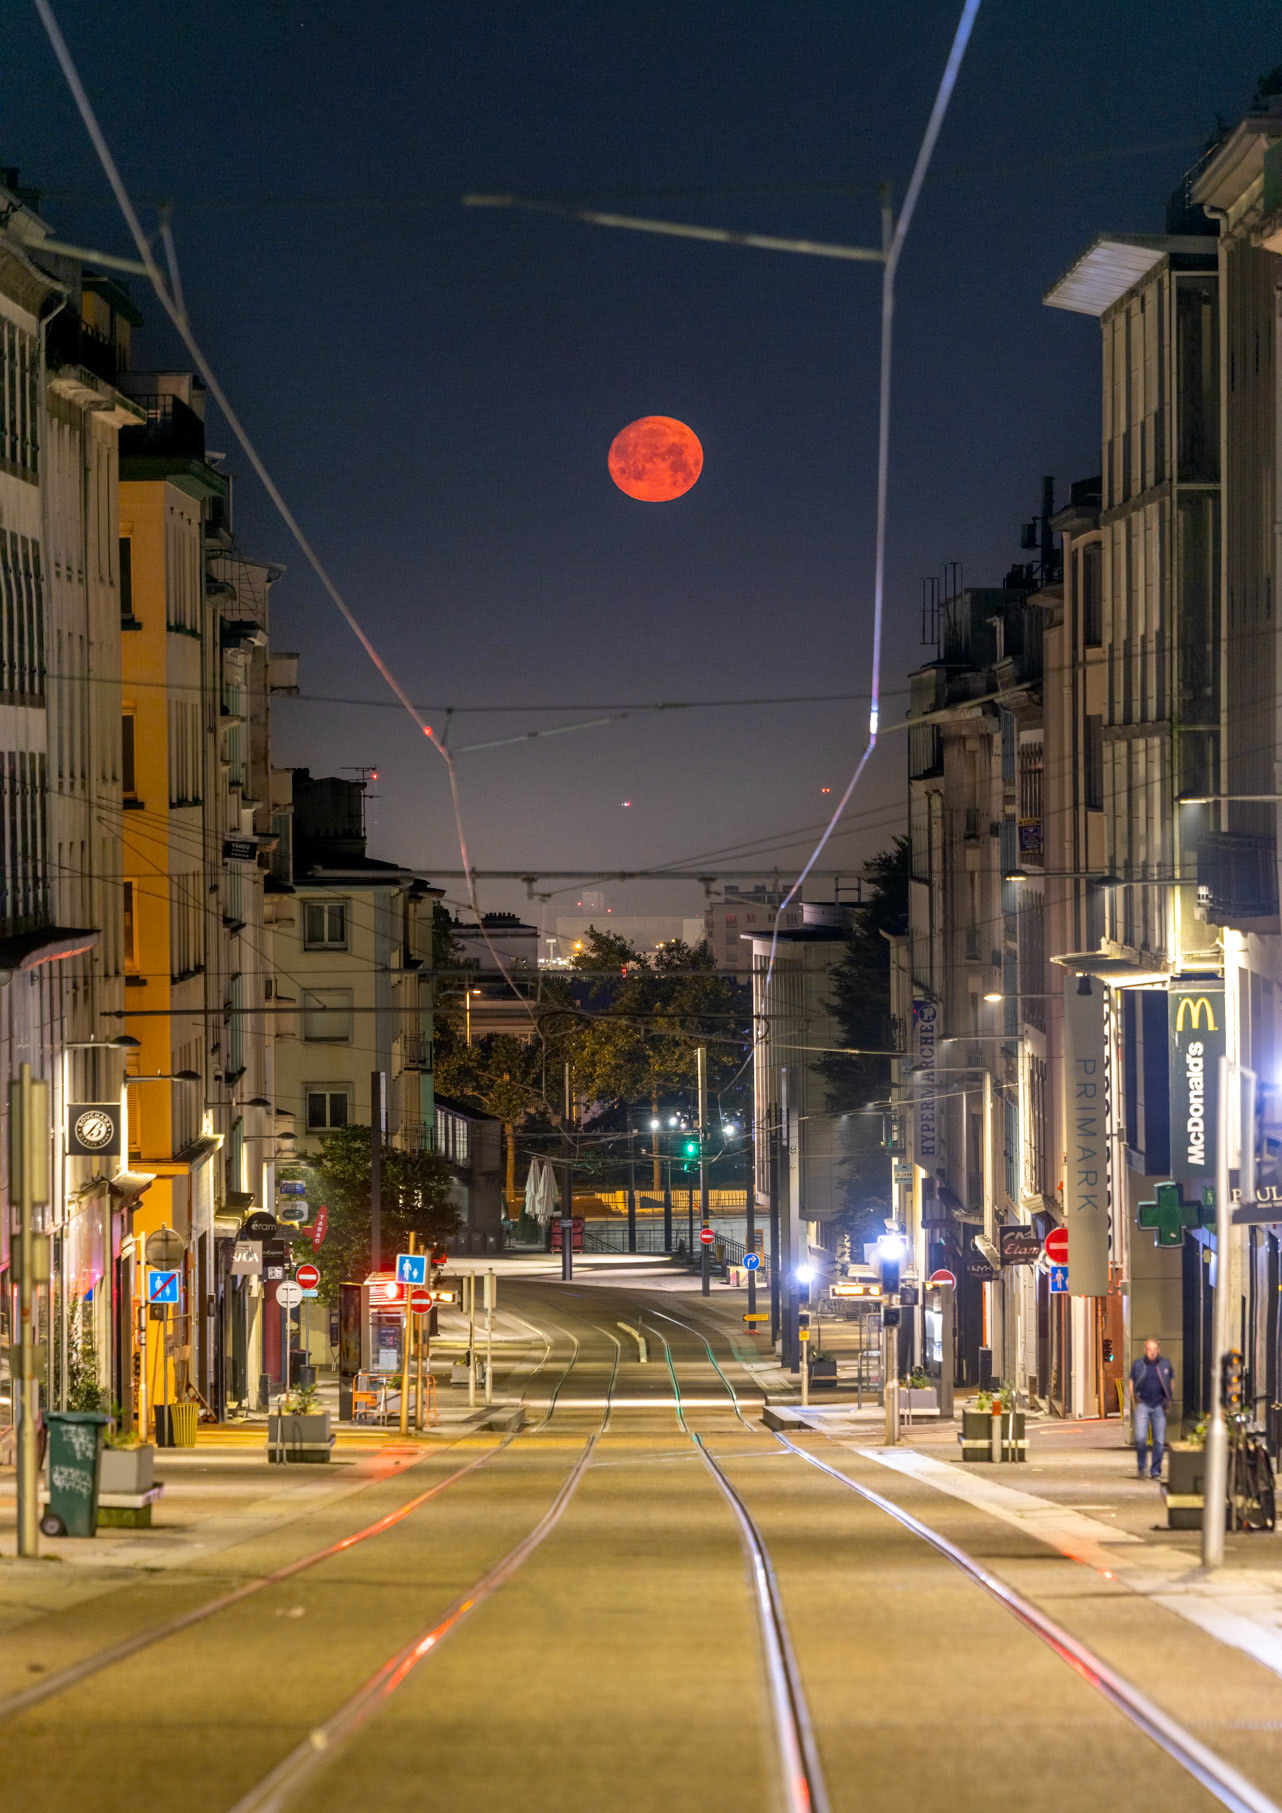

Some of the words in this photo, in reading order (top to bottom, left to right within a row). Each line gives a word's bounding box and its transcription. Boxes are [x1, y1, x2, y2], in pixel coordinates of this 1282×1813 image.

[1186, 1041, 1205, 1166] McDonald's
[78, 1111, 111, 1127] BOUCHARA
[1074, 1058, 1098, 1212] PRIMARK
[1231, 1185, 1282, 1204] PUL
[251, 1220, 277, 1231] éram
[314, 1214, 324, 1244] TABAC
[1004, 1243, 1040, 1255] Etam
